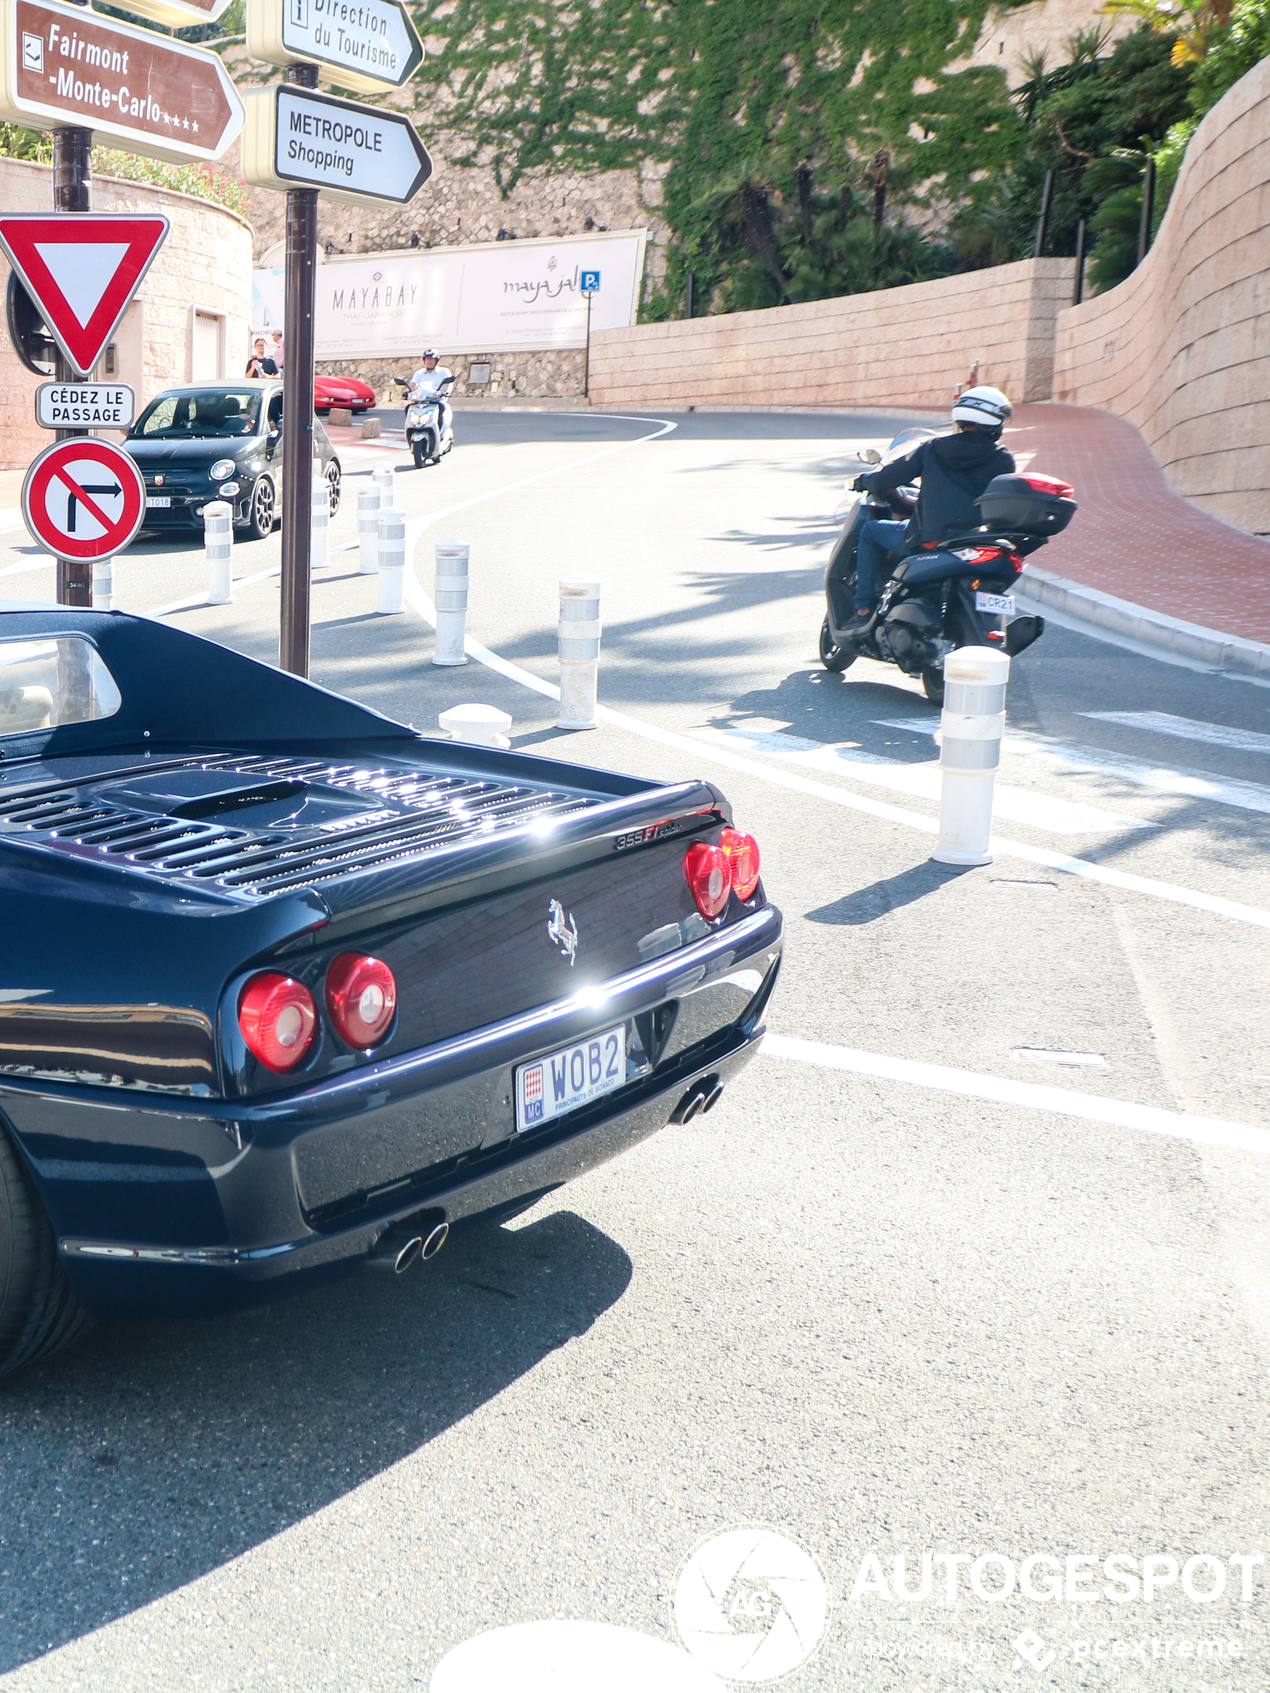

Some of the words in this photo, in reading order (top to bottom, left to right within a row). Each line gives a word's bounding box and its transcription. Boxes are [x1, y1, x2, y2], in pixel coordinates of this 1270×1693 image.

[48, 23, 129, 75] Fairmont
[314, 22, 331, 48] du
[337, 28, 397, 70] Tourisme
[290, 111, 382, 153] METROPOLE
[288, 139, 355, 176] Shopping
[332, 284, 418, 310] MAYABAY
[503, 280, 553, 304] maya
[50, 387, 99, 404] CÉDEZ
[106, 391, 124, 405] LE
[52, 407, 121, 422] PASSAGE
[988, 596, 1013, 610] CR21
[587, 1088, 594, 1097] DE
[595, 1077, 615, 1092] MONACO
[527, 1102, 541, 1120] MC
